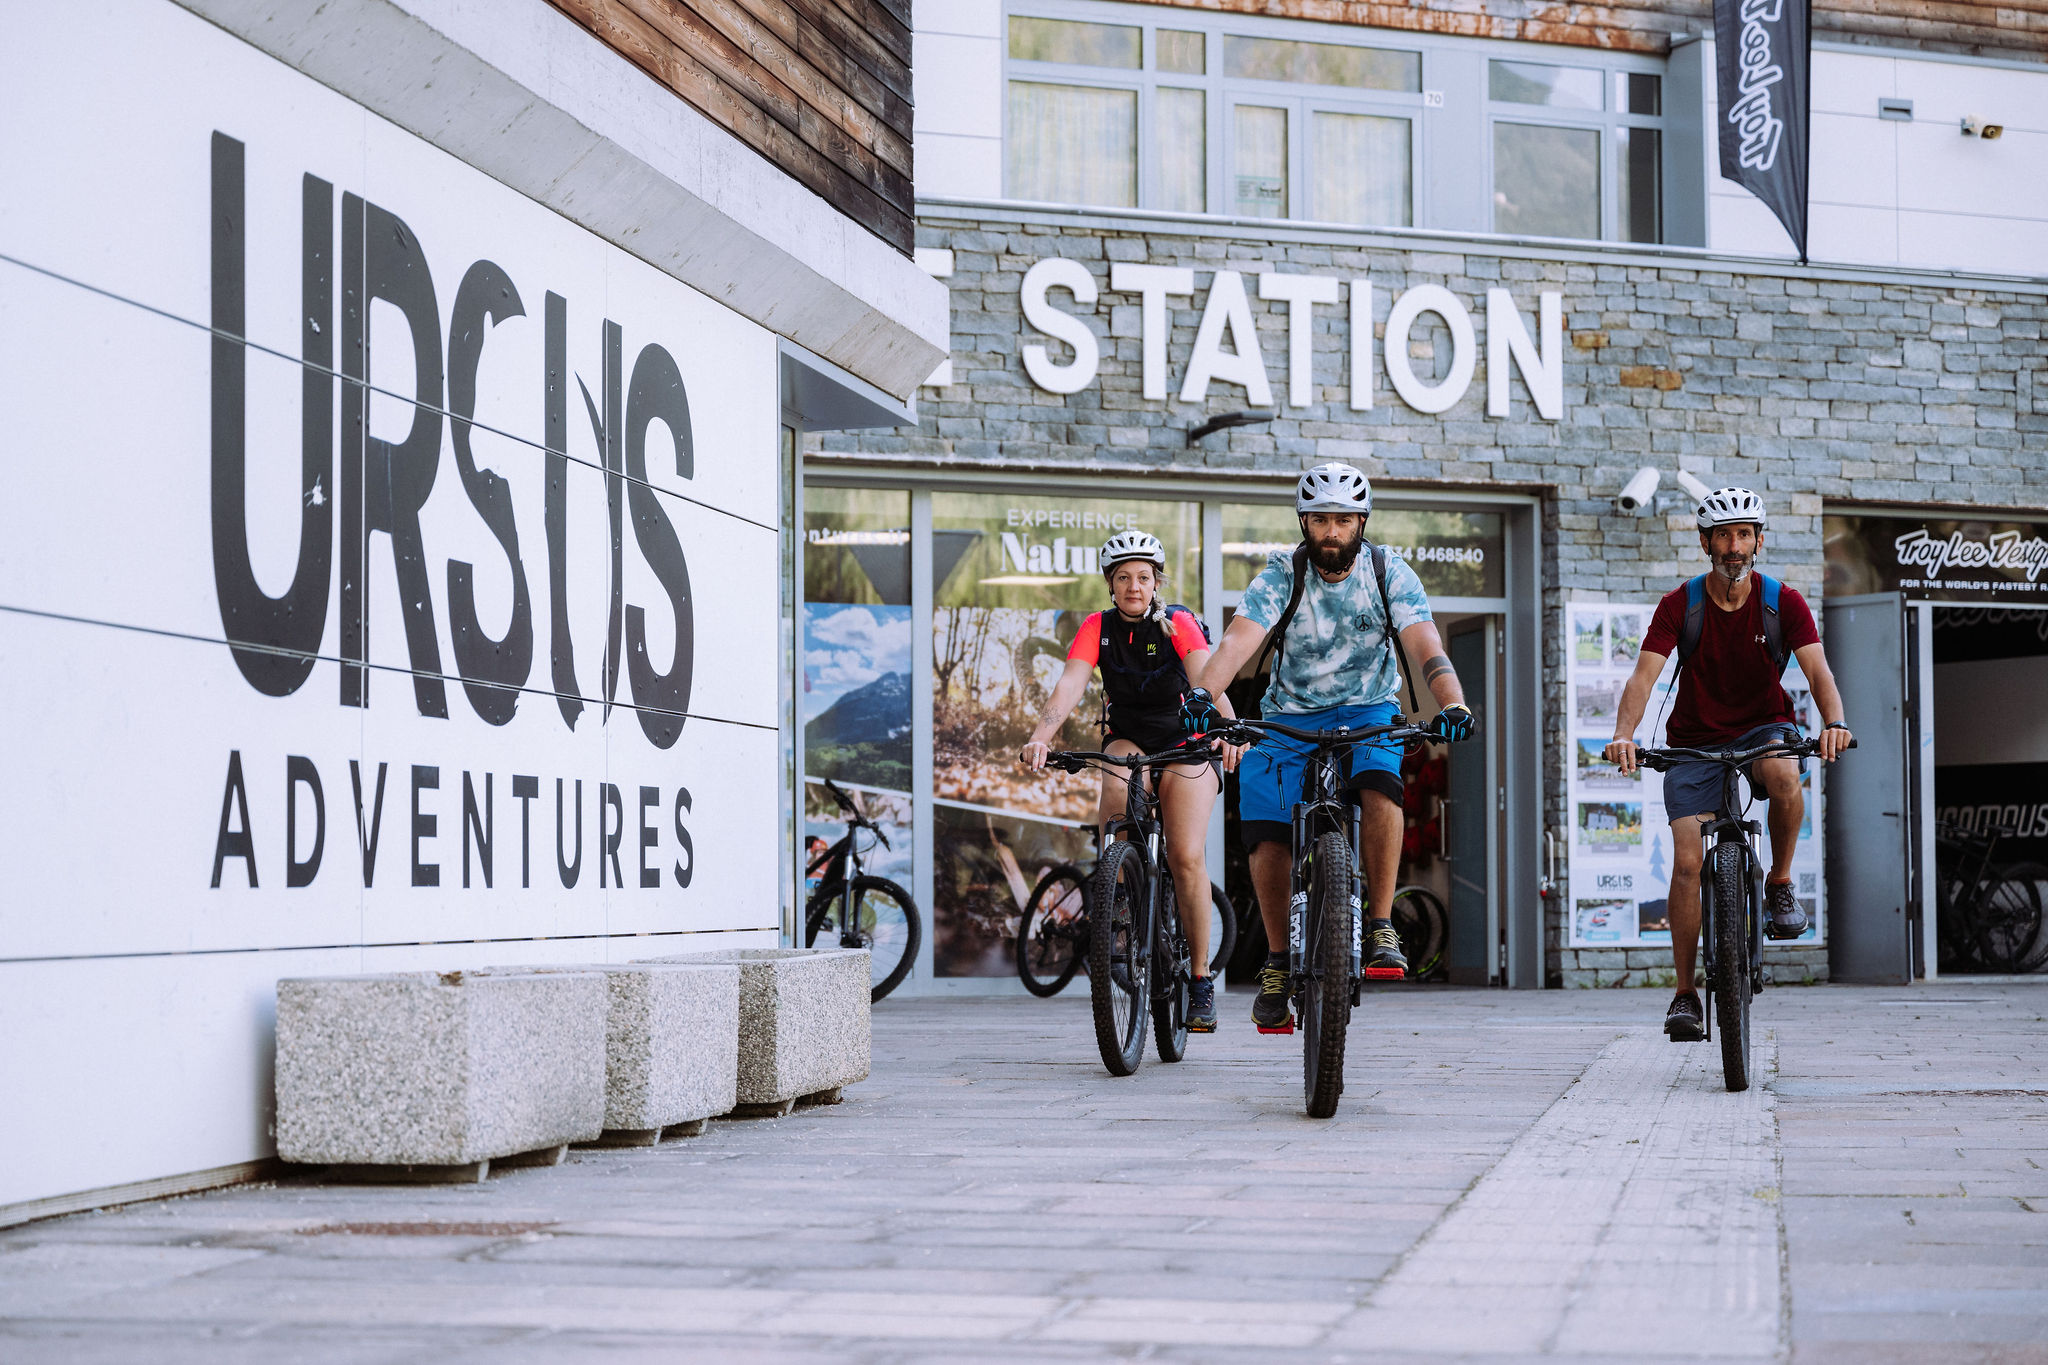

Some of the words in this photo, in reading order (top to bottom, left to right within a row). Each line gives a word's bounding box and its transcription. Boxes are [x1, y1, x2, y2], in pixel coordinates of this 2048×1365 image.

[1427, 93, 1442, 104] 70
[1020, 257, 1563, 420] STATION
[211, 129, 694, 750] URSUS
[1007, 508, 1138, 530] EXPERIENCE
[1000, 531, 1104, 575] Natu
[1416, 546, 1484, 563] 8468540
[1900, 579, 1920, 588] FOR
[1922, 579, 1943, 589] THE
[1945, 580, 1990, 590] WORLD'S
[1992, 581, 2038, 591] FASTEST
[211, 750, 694, 889] ADVENTURES
